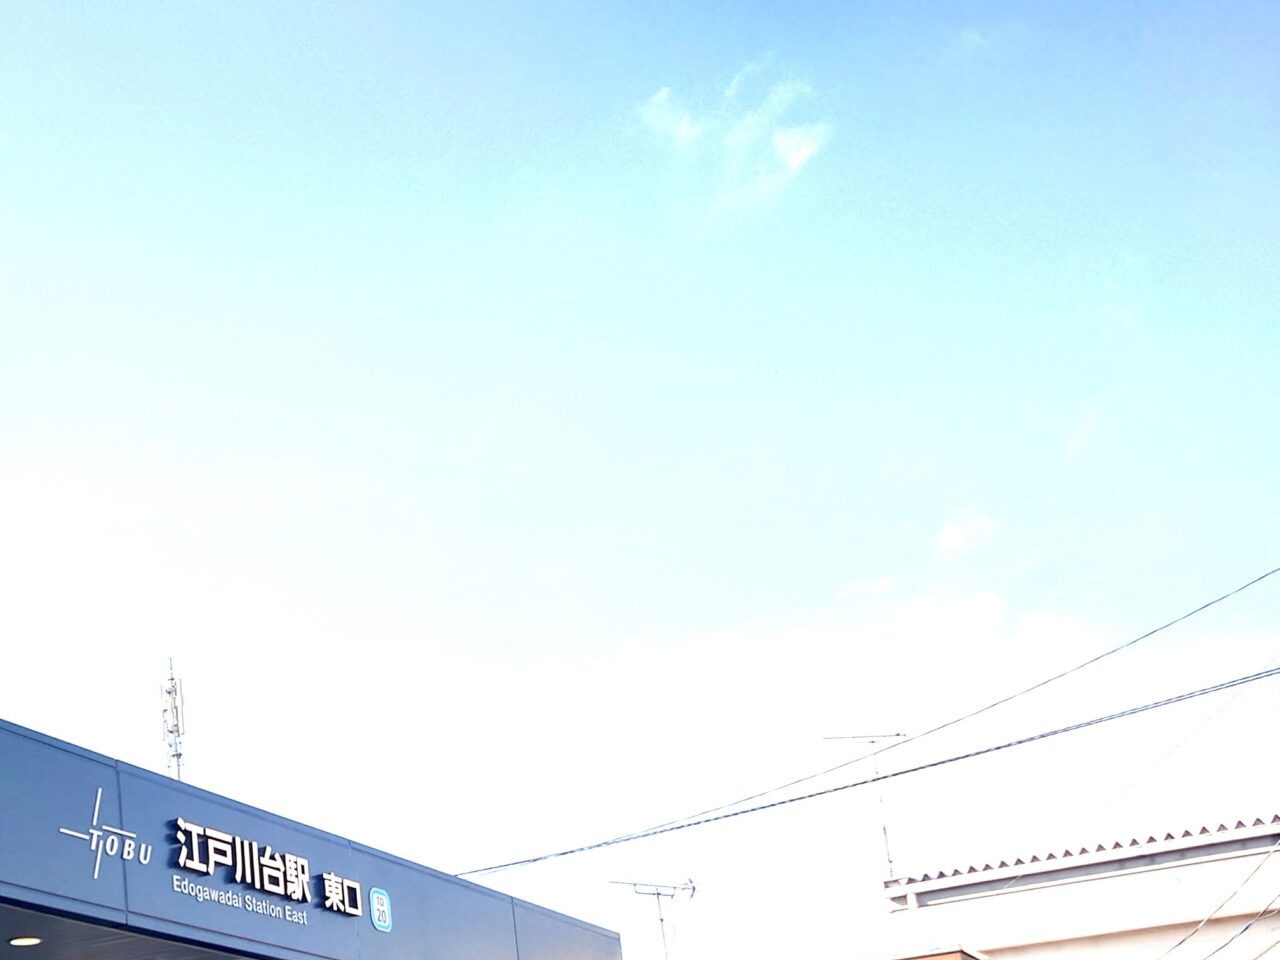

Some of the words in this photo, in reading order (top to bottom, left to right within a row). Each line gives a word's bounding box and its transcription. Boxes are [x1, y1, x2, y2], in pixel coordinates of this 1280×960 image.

[89, 828, 152, 865] TOBU
[176, 817, 311, 903] 江戸川台駅
[322, 872, 362, 917] 東口
[172, 875, 242, 909] Edogawadai
[245, 892, 283, 919] Station
[285, 907, 308, 925] East
[376, 908, 387, 923] 20
